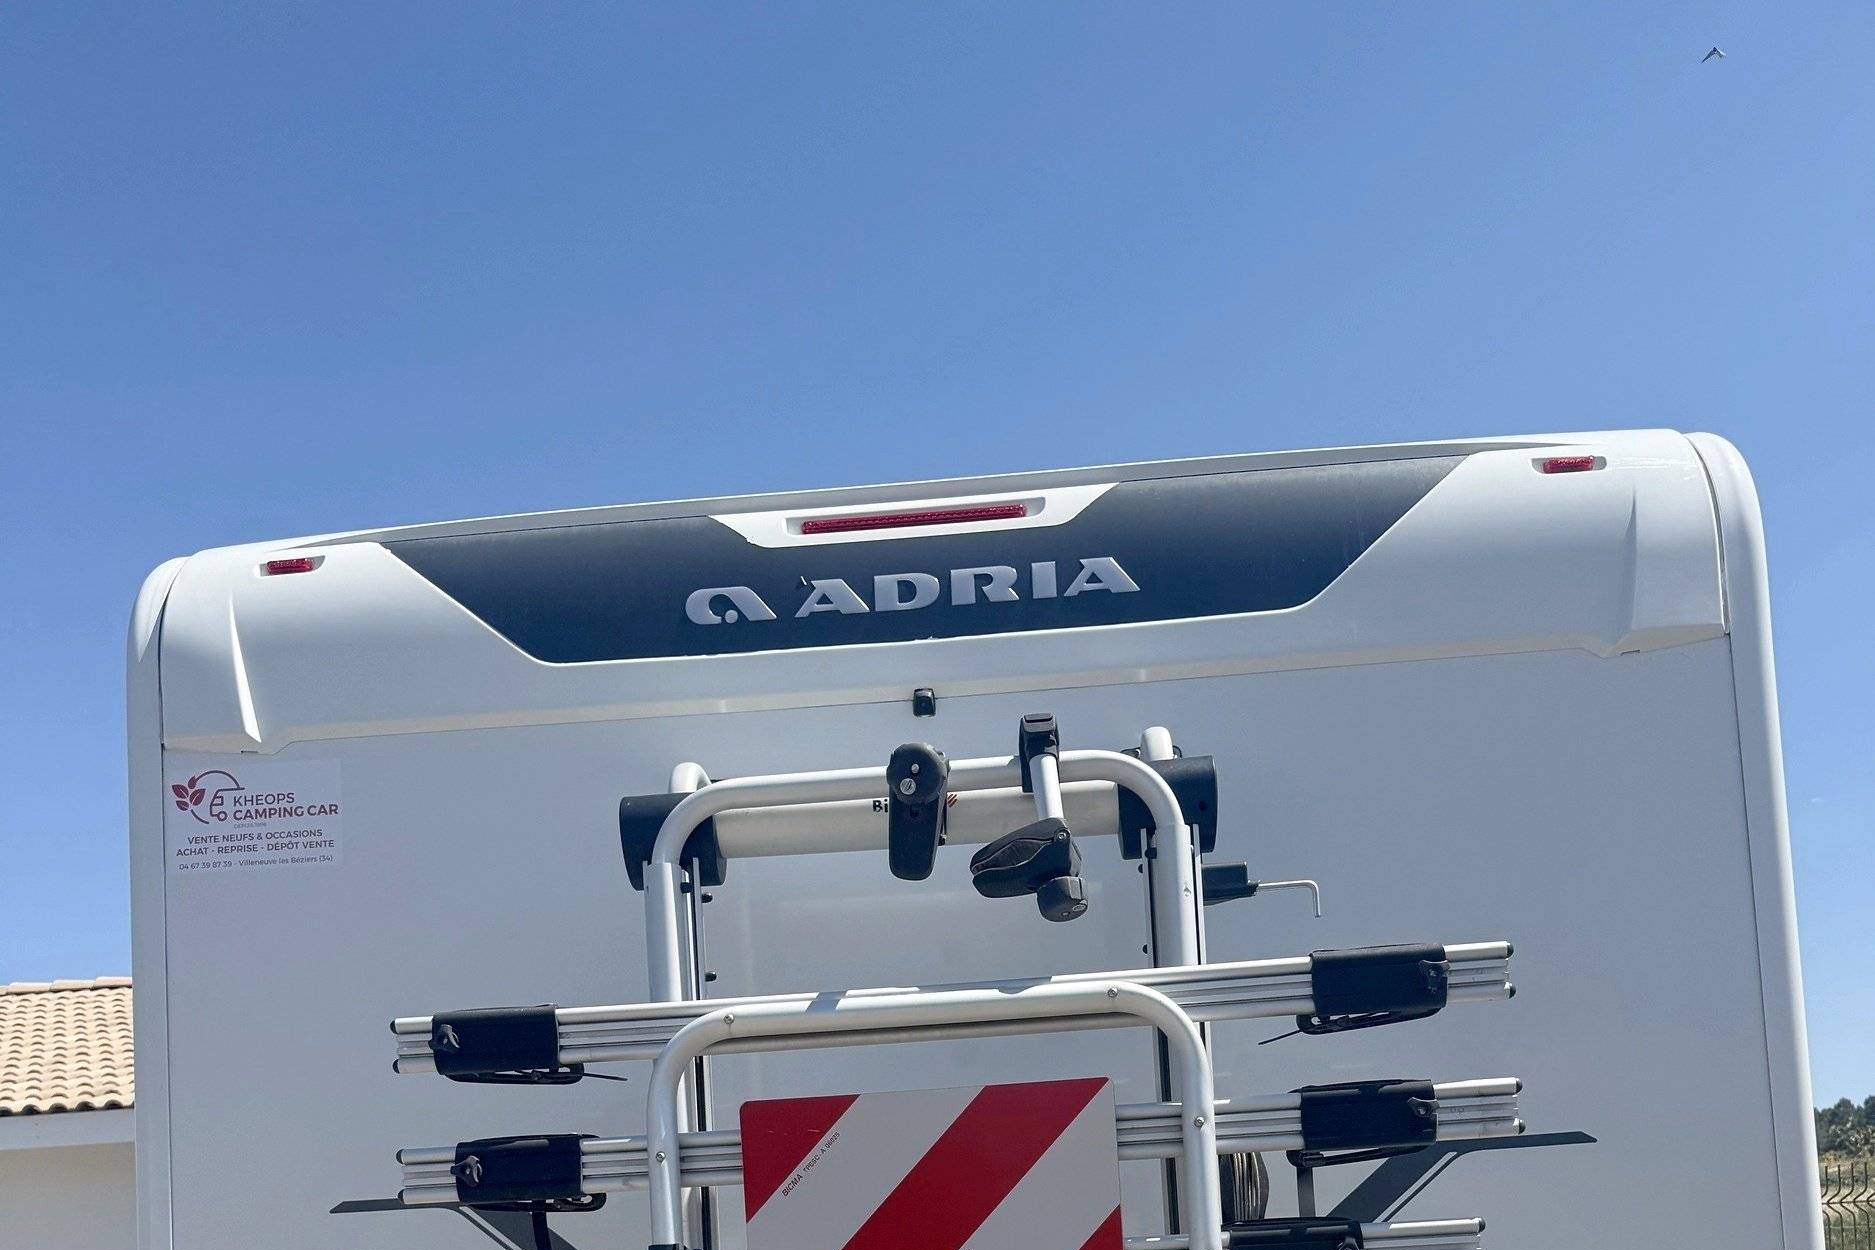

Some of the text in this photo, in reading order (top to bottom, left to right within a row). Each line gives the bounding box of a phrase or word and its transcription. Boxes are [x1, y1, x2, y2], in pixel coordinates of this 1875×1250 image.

[795, 557, 1140, 617] ADRIA
[233, 792, 295, 807] KHEOPS
[233, 804, 339, 821] CAMPING CAR
[187, 829, 323, 845] VENTE NEUFS & OCCASIONS
[176, 847, 209, 857] ACHAT
[217, 844, 259, 854] REPRISE
[266, 840, 300, 851] DÉPÔT
[302, 839, 335, 849] VENTE
[190, 862, 200, 870] 67
[781, 1173, 804, 1197] BICMA
